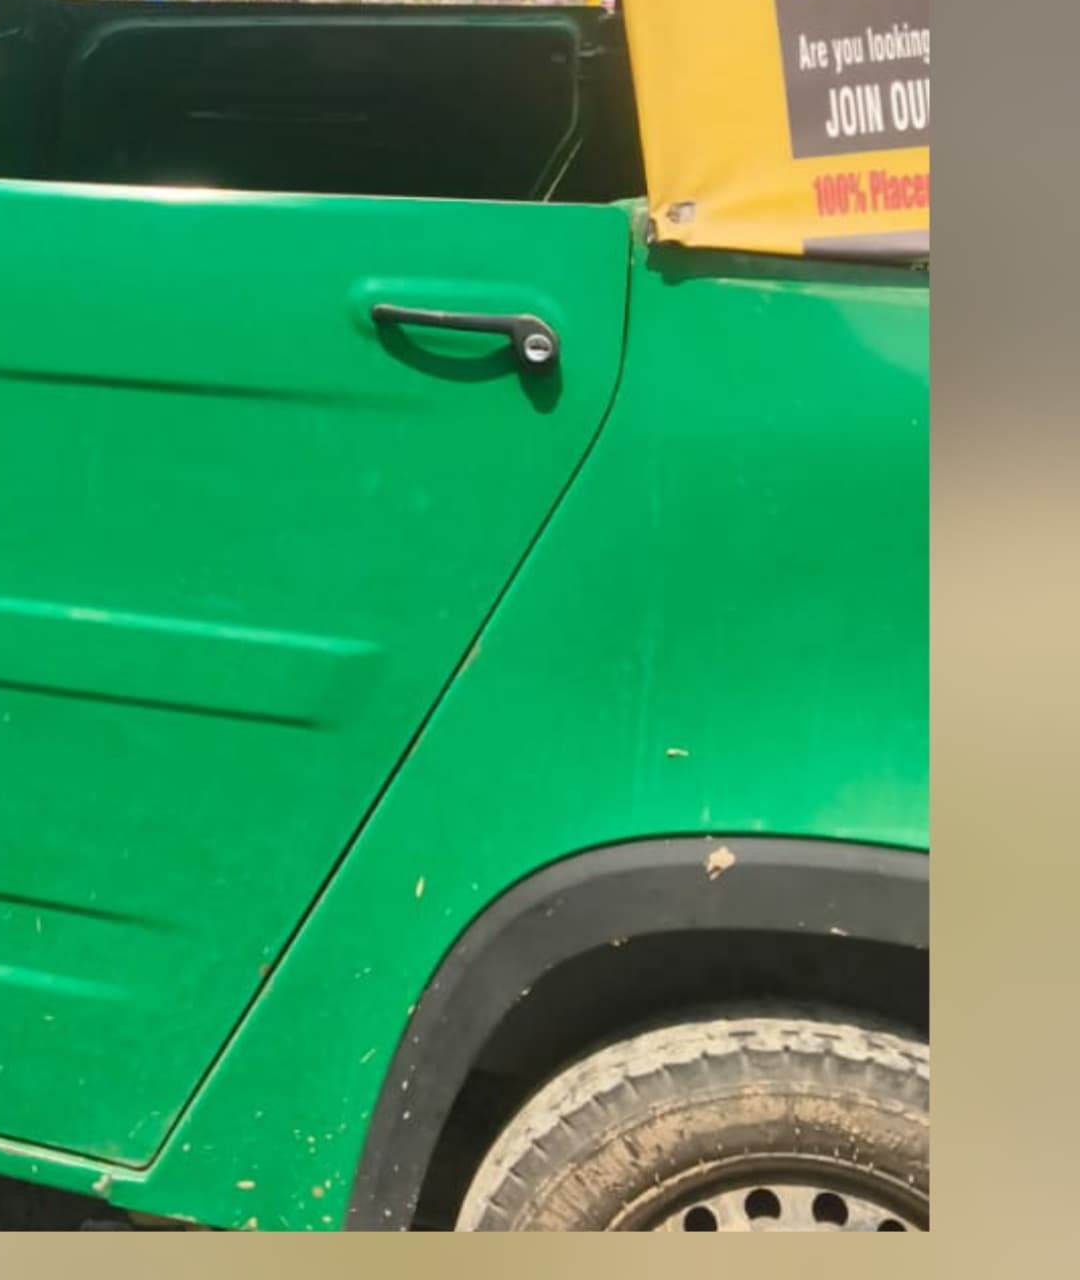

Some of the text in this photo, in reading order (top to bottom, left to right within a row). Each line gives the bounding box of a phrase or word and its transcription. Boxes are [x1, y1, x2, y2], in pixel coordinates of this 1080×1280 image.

[799, 22, 930, 75] Are you looking
[825, 77, 930, 138] JOIN OU
[813, 171, 868, 218] 100%
